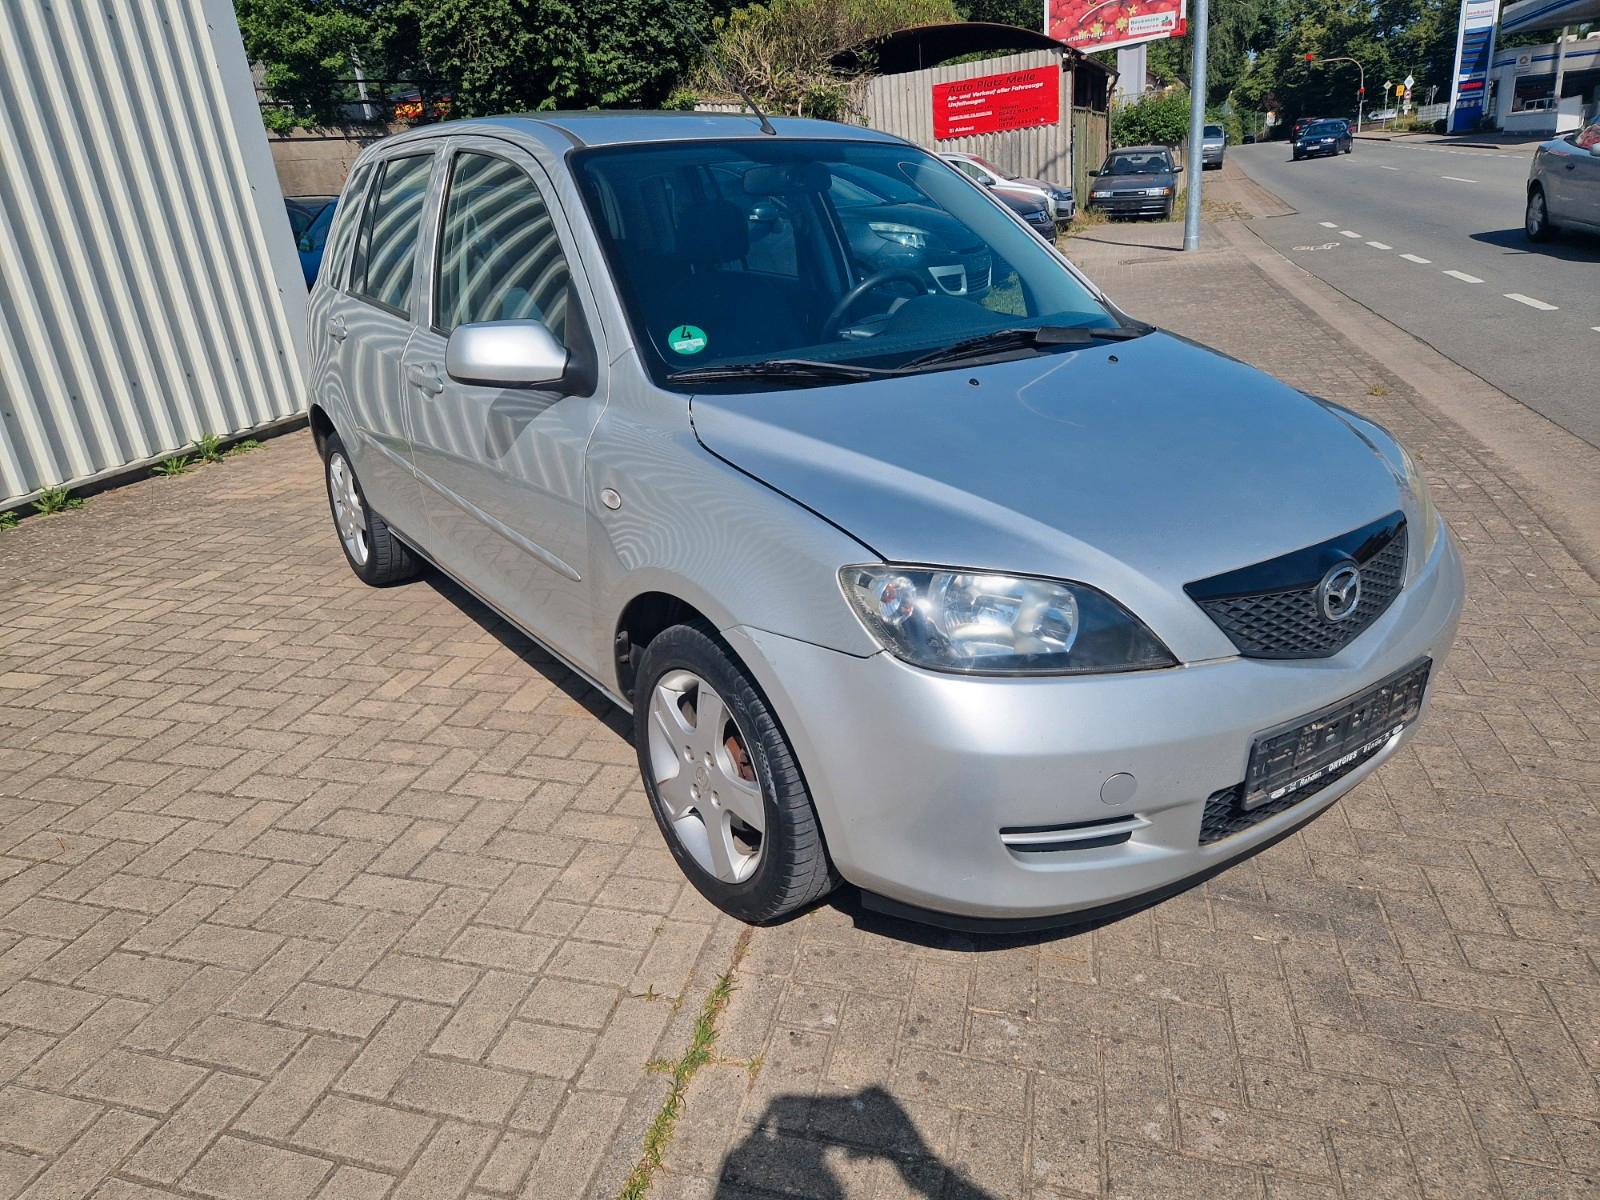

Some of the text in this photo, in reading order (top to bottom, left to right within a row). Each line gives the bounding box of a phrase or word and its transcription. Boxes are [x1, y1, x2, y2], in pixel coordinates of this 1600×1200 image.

[948, 73, 1036, 93] Auto Platz Melle
[959, 92, 971, 100] und
[972, 88, 996, 98] Verkauf
[996, 86, 1010, 94] aller
[1010, 81, 1044, 92] Fahrzeuge
[947, 98, 986, 109] Unfallwagen
[681, 326, 692, 339] 4
